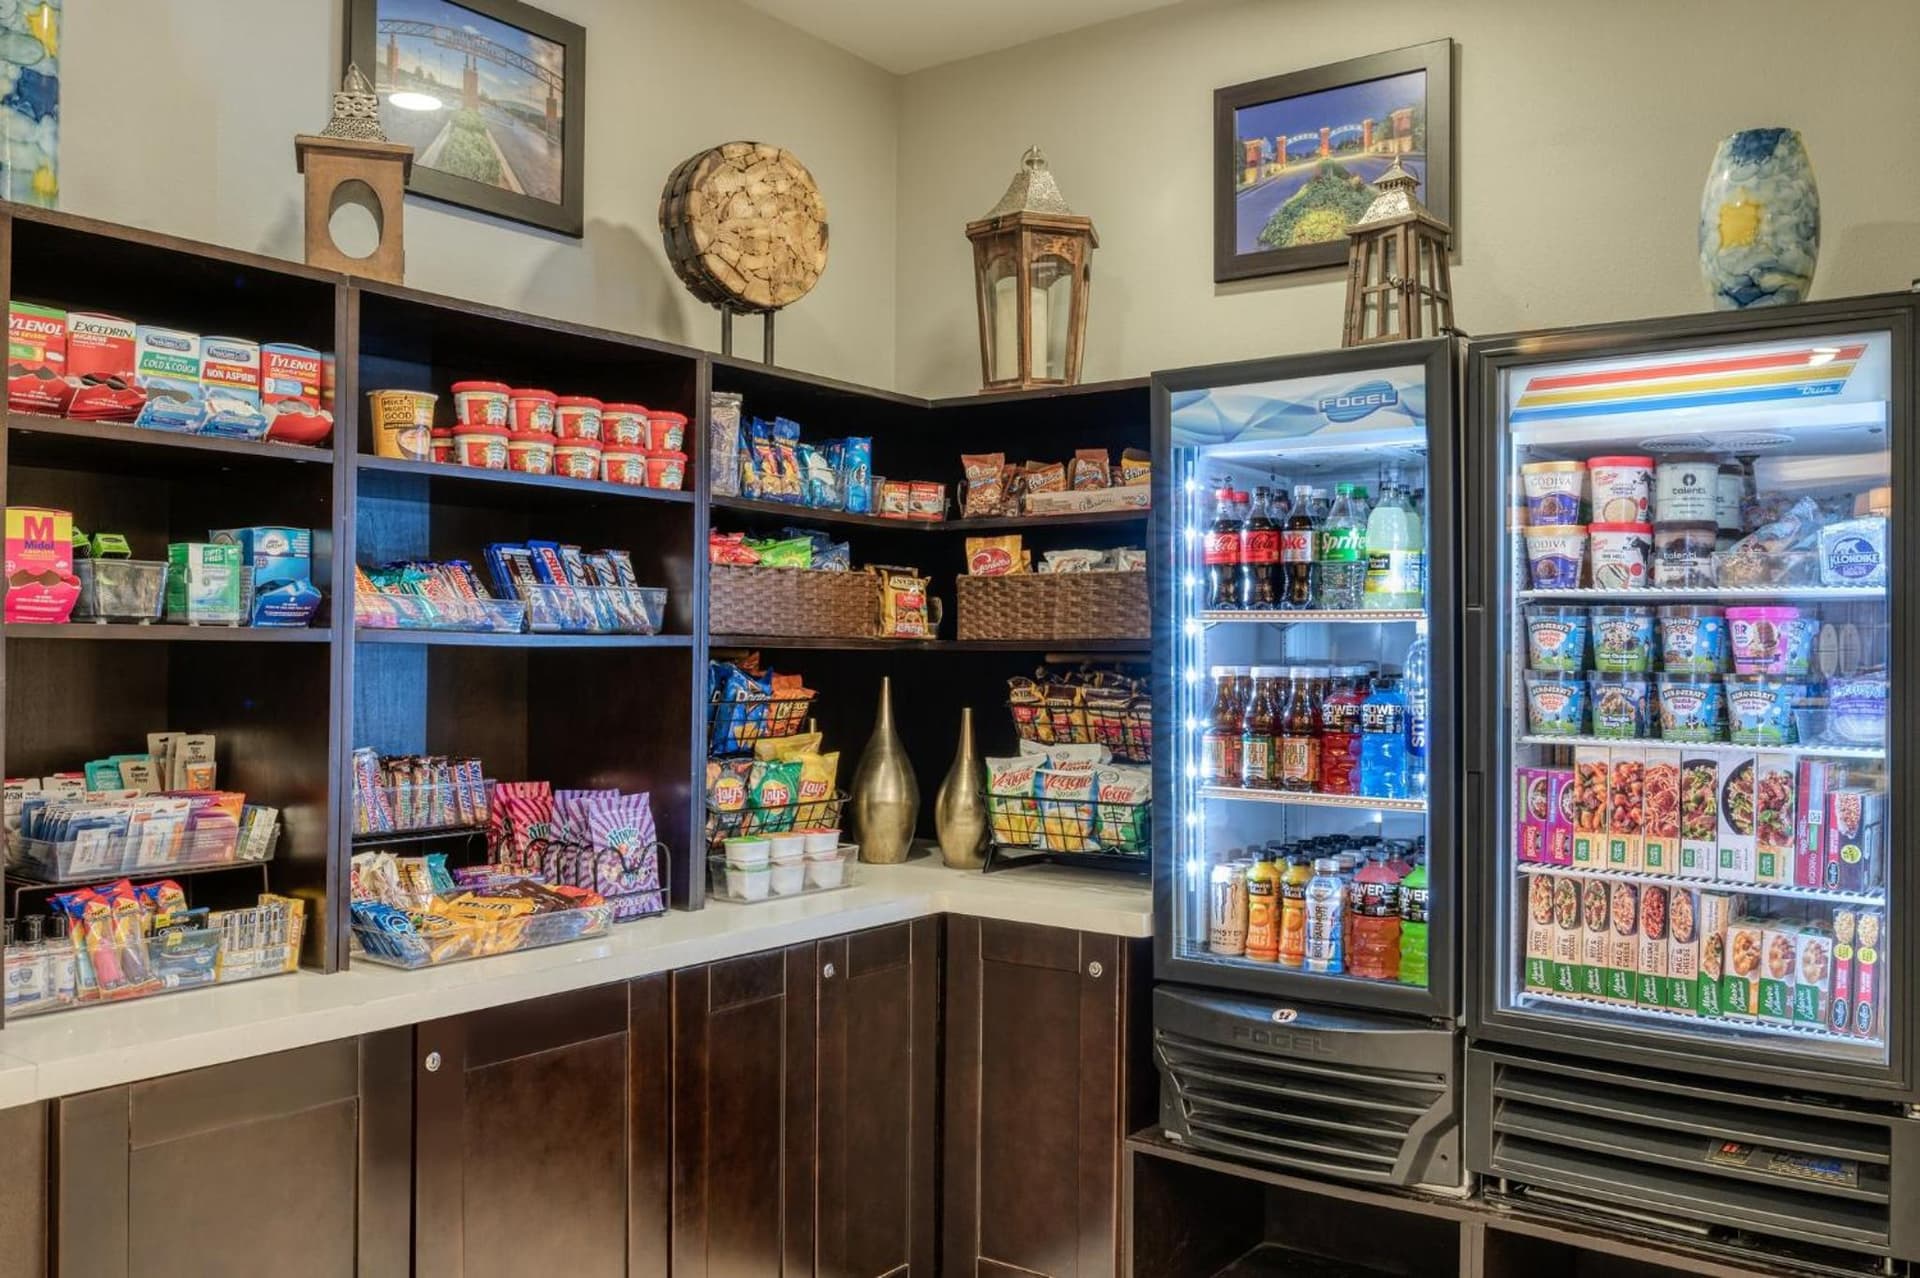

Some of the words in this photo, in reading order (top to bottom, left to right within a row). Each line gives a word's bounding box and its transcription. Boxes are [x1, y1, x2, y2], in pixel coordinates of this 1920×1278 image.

[74, 320, 133, 338] EXCEDRIN
[270, 353, 319, 373] TYLENOL
[206, 368, 225, 379] NON
[226, 370, 257, 384] ASPIRIN
[1320, 392, 1394, 409] FOGEL
[384, 411, 412, 420] GOOD
[24, 516, 54, 541] M
[24, 540, 55, 551] Midol
[1322, 526, 1366, 553] Sprite
[1830, 553, 1880, 566] KLONDIKE
[1363, 704, 1402, 716] POWER
[1044, 774, 1093, 791] Veggie
[1616, 950, 1624, 967] MAC
[1623, 942, 1631, 968] CHEESE
[1682, 948, 1691, 975] CHEESE
[1675, 956, 1683, 974] MAC
